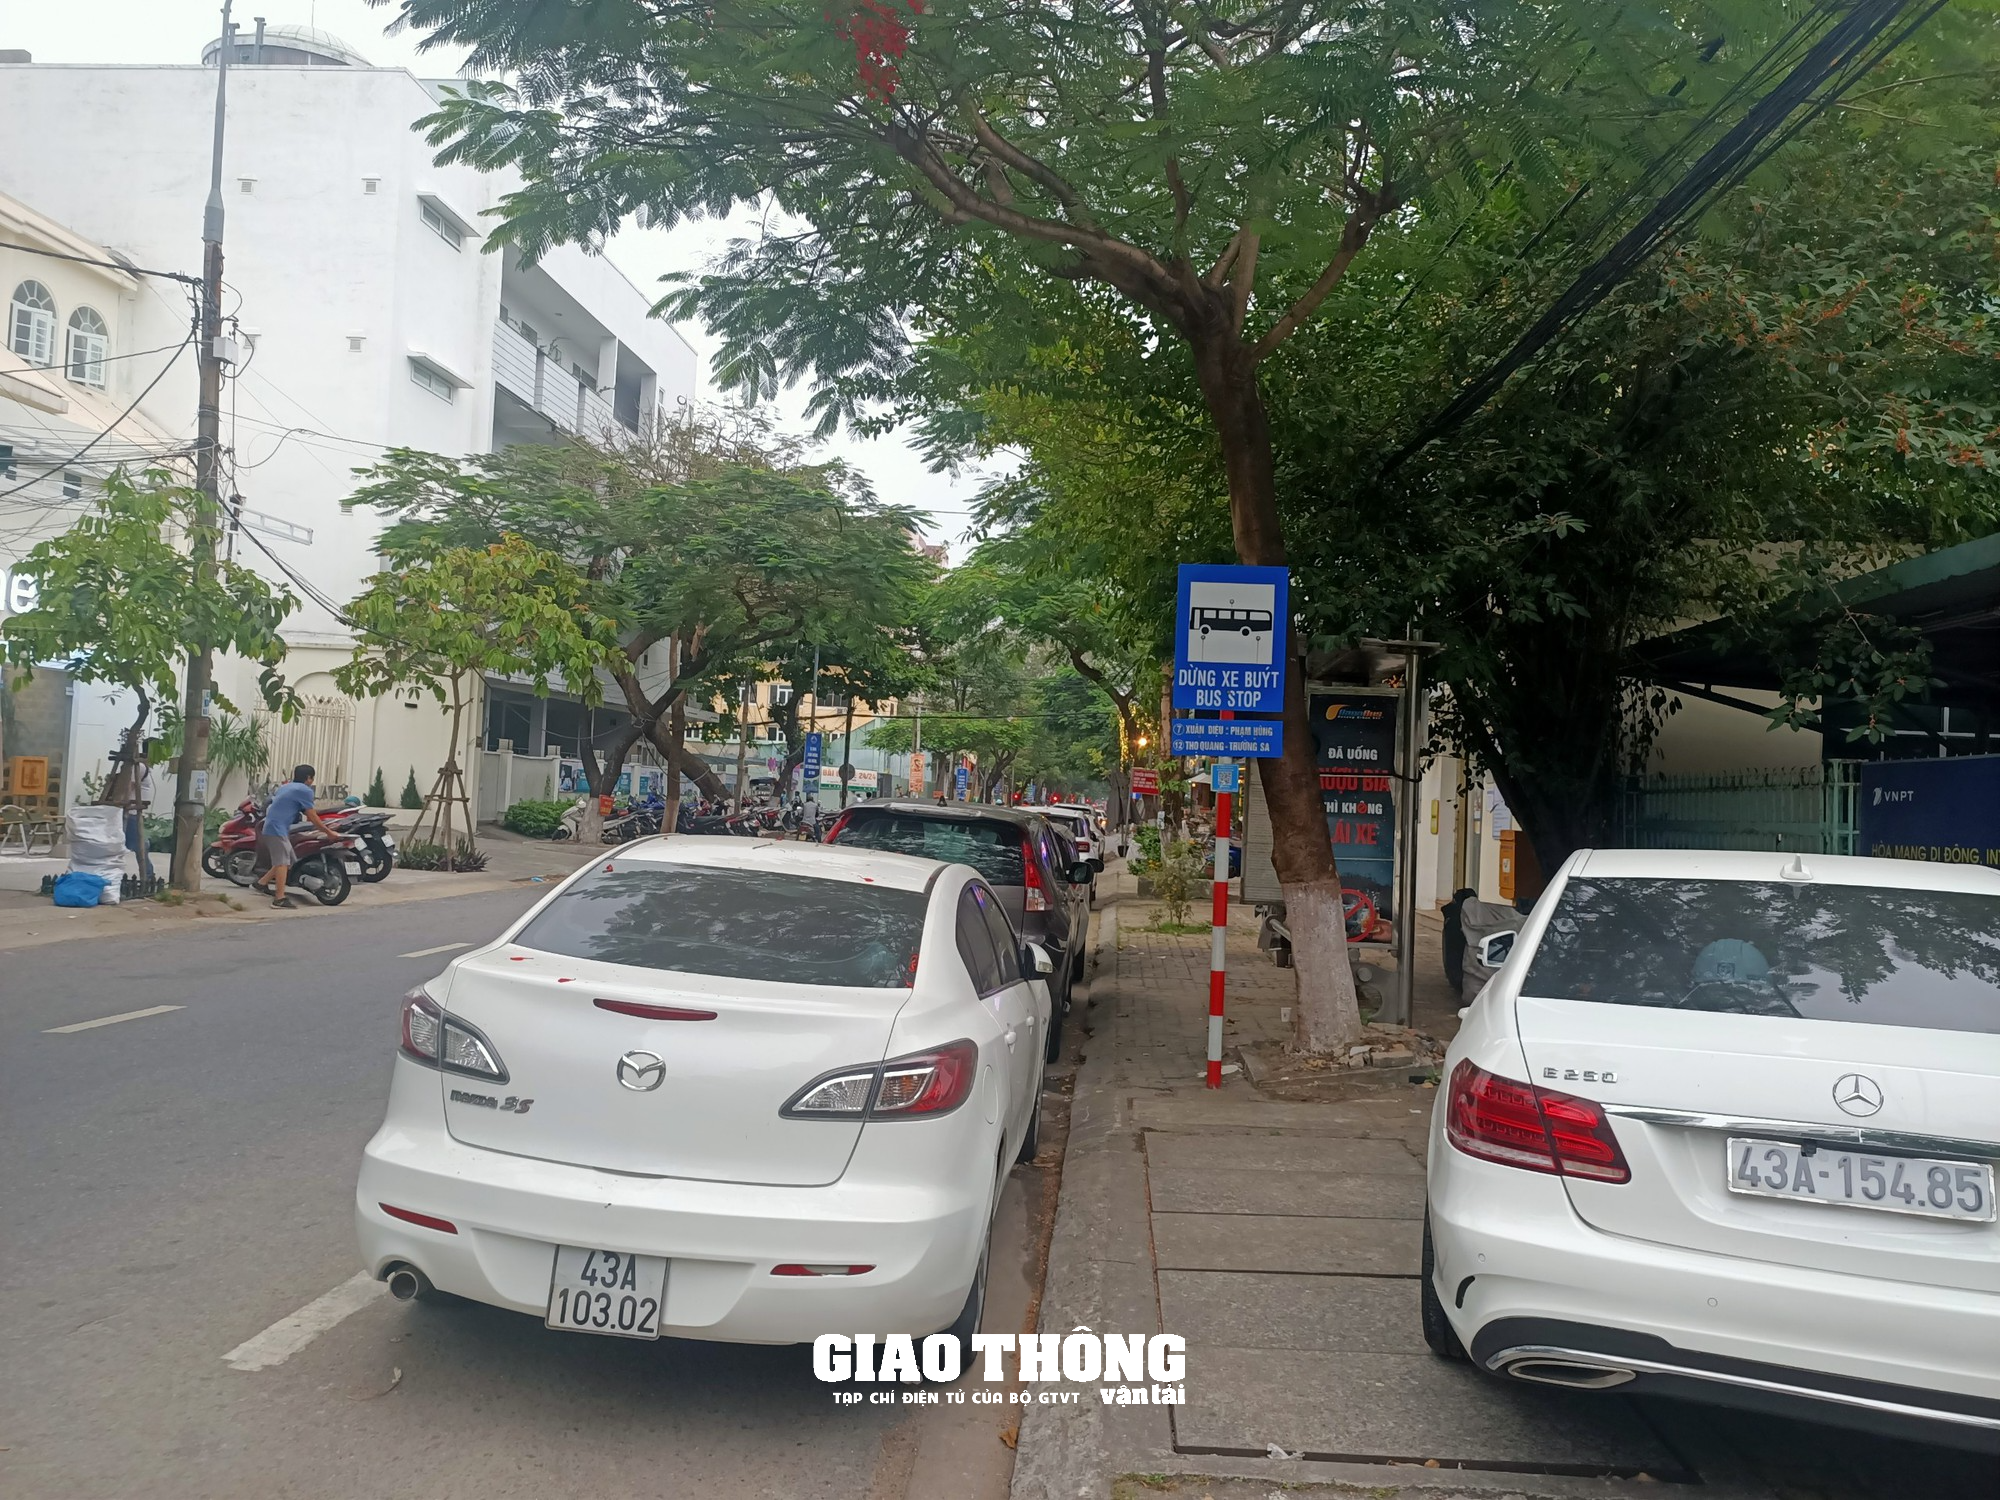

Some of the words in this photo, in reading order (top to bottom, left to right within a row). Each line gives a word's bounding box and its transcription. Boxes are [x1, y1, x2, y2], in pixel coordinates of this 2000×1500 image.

[1178, 664, 1216, 687] DỪNG
[1221, 670, 1239, 688] XE
[1244, 666, 1279, 688] BUÝT
[1196, 689, 1222, 707] BUS
[1227, 690, 1262, 708] STOP
[1230, 726, 1252, 738] PHẠM
[1200, 741, 1225, 752] QUANG
[1260, 742, 1270, 752] SA
[1328, 745, 1344, 759] ĐÃ
[1347, 745, 1378, 760] UỐNG
[1362, 768, 1392, 792] BIA
[1884, 790, 1914, 802] VNPT
[1324, 799, 1338, 813] HÌ
[1341, 800, 1383, 815] KHÔNG
[1331, 818, 1351, 845] ÁI
[1355, 823, 1377, 845] XE
[1930, 846, 1941, 861] DI
[1737, 1145, 1983, 1213] 43A-154.85
[580, 1250, 637, 1292] 43A
[558, 1288, 658, 1334] 103.02
